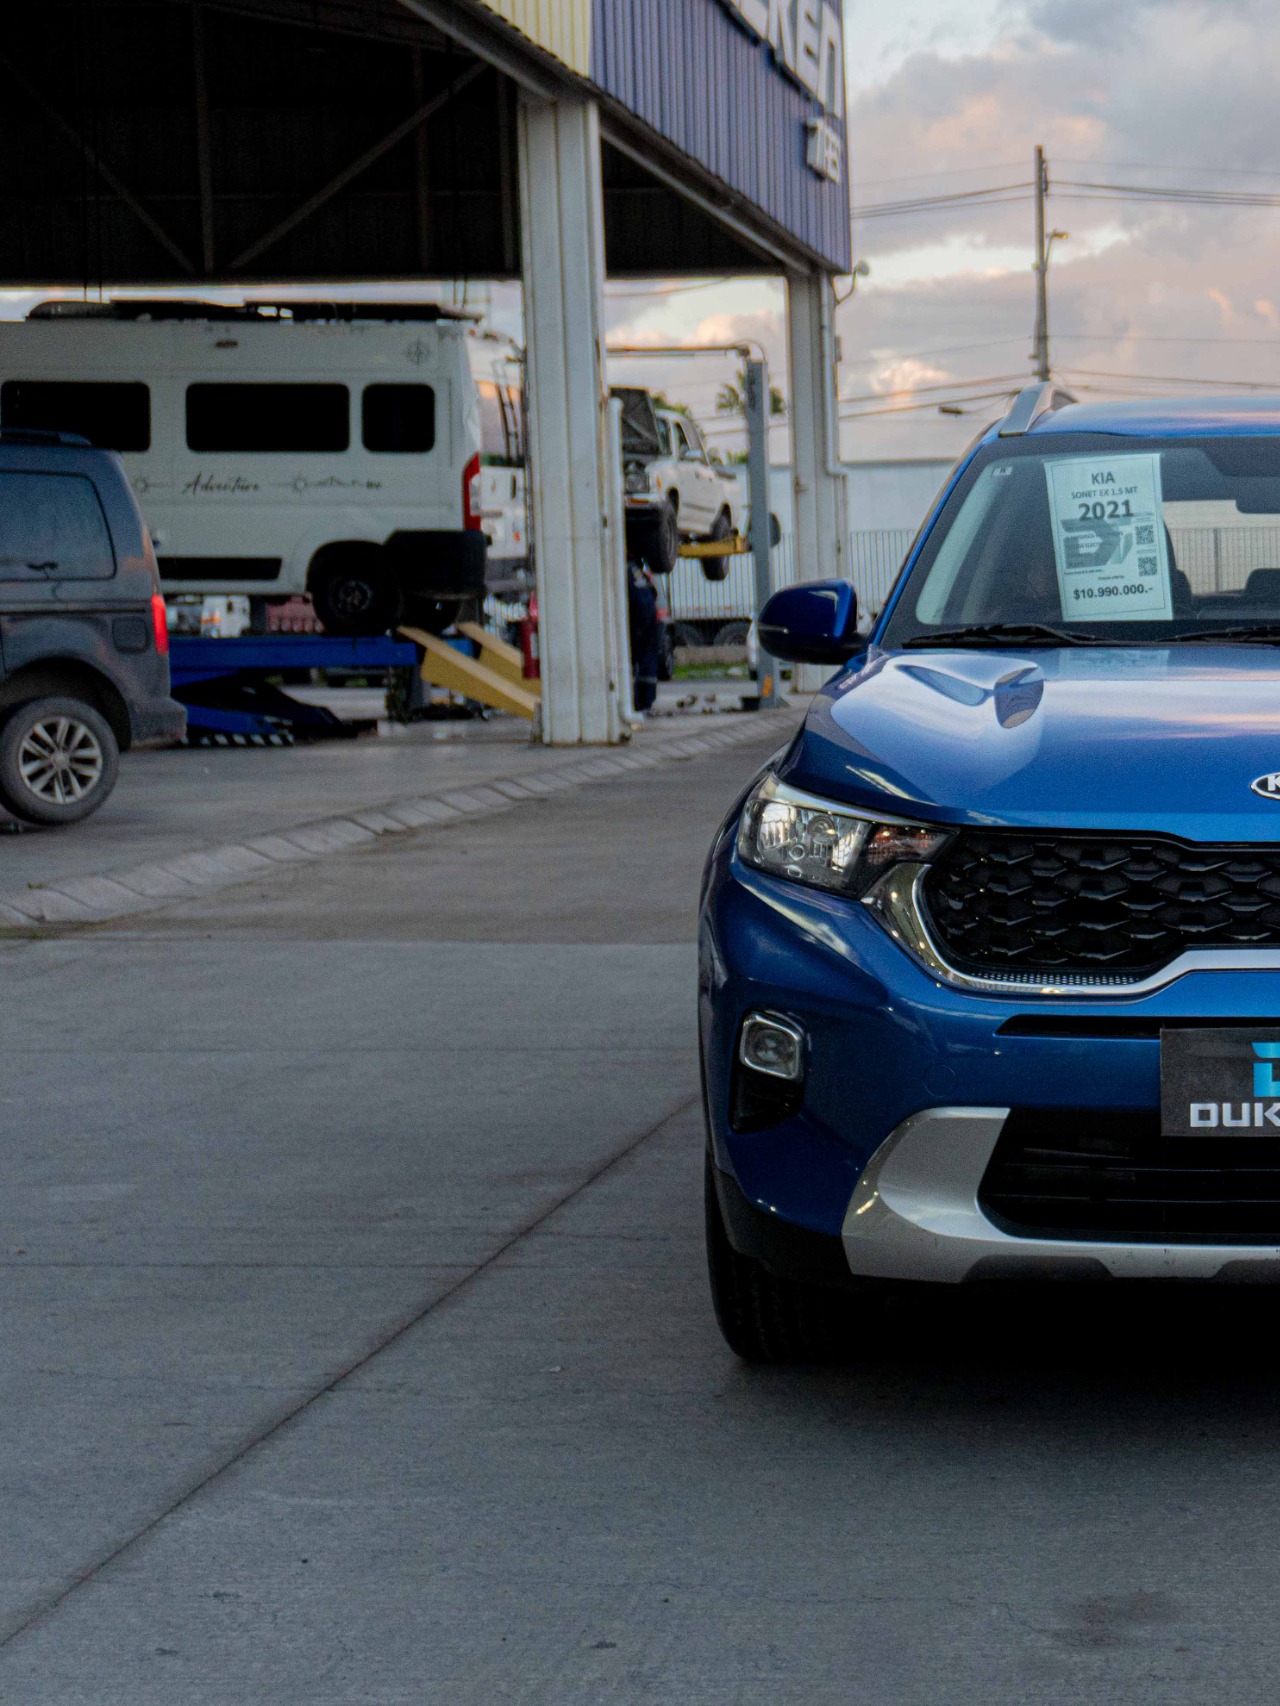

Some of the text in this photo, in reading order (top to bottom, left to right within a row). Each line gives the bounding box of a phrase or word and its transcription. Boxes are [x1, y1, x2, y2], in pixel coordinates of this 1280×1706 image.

[1091, 471, 1116, 485] KIA
[1071, 485, 1138, 499] SONET EX 1.5 MT
[1078, 499, 1134, 522] 2021
[1073, 583, 1153, 600] $10.990.000.-
